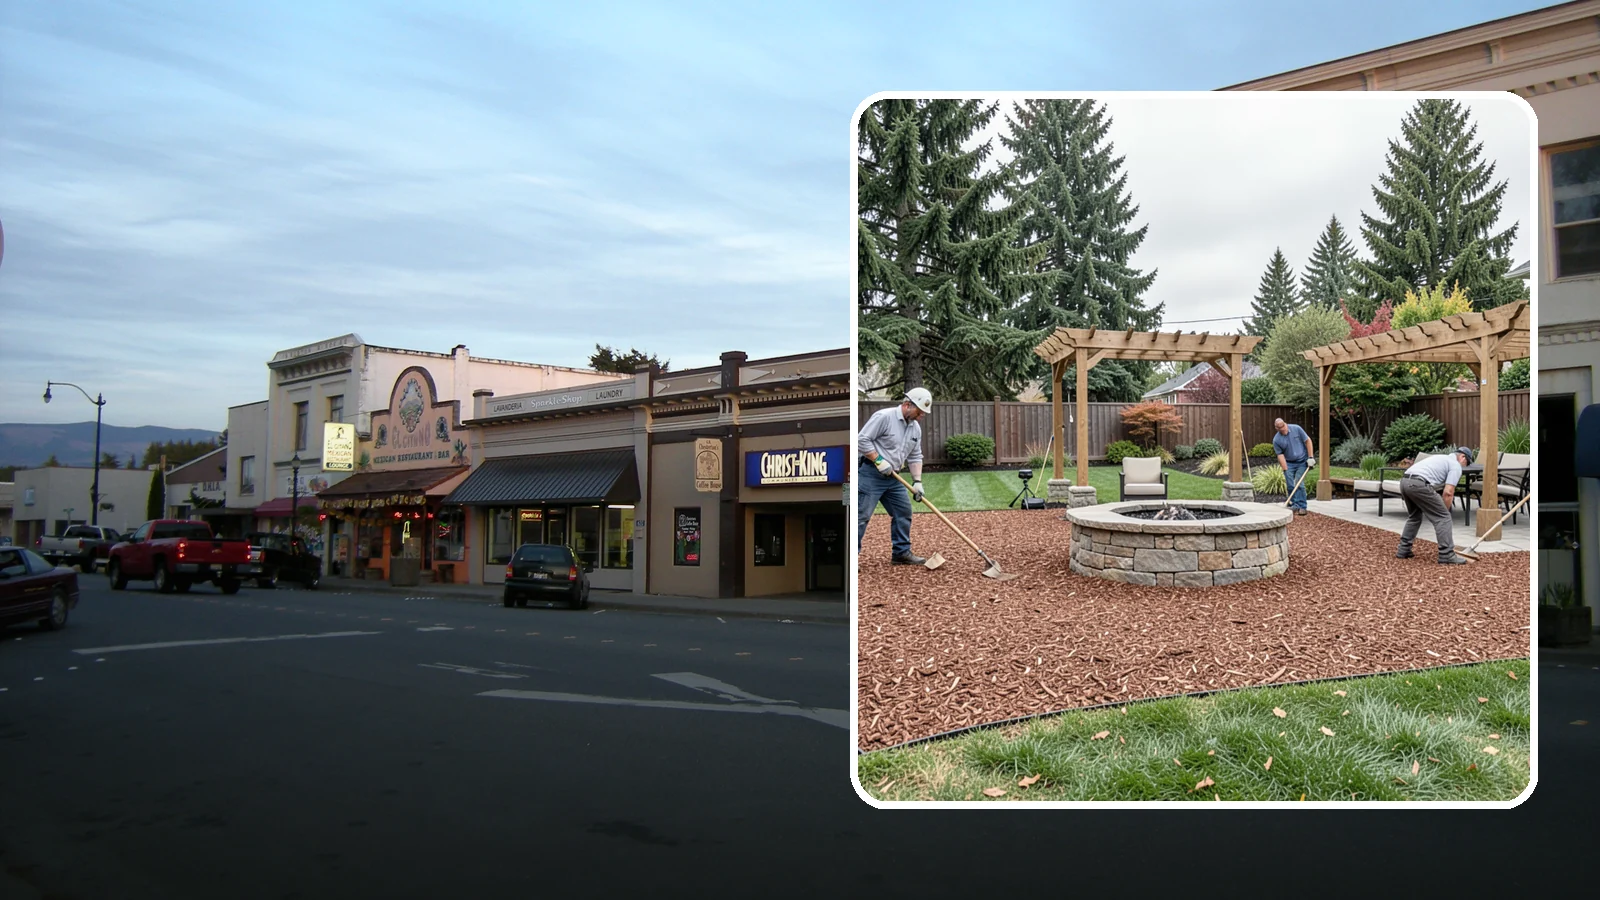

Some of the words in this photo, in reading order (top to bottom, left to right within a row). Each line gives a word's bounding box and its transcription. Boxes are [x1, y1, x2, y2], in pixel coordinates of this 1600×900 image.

[530, 396, 561, 409] Sparkle
[562, 394, 582, 405] Shop
[595, 389, 624, 400] LAUNDRY
[493, 402, 522, 412] LAVANDERIA
[392, 425, 402, 449] EL
[373, 454, 396, 464] MEXICAN
[397, 451, 434, 462] RESTAURANT
[437, 450, 450, 459] BAR
[761, 452, 797, 477] CHRIST
[799, 450, 827, 476] KING
